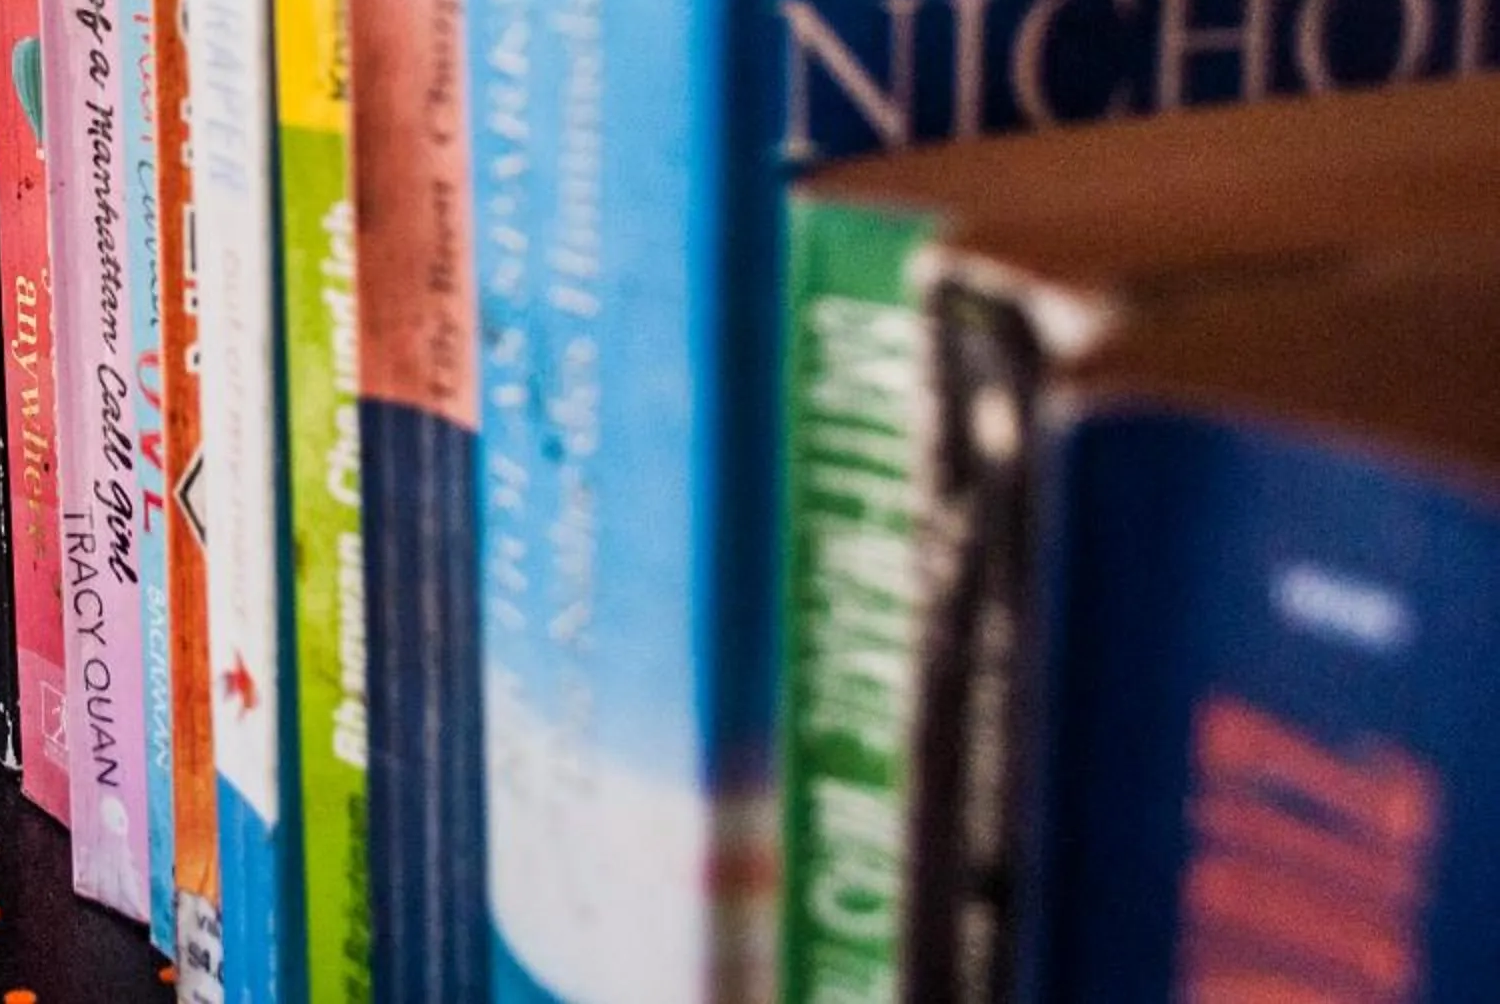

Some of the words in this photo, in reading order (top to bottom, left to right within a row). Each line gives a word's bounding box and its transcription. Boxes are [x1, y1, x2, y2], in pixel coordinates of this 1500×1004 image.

[89, 49, 112, 92] a
[64, 507, 107, 645] TRACY
[83, 658, 119, 787] QUAN
